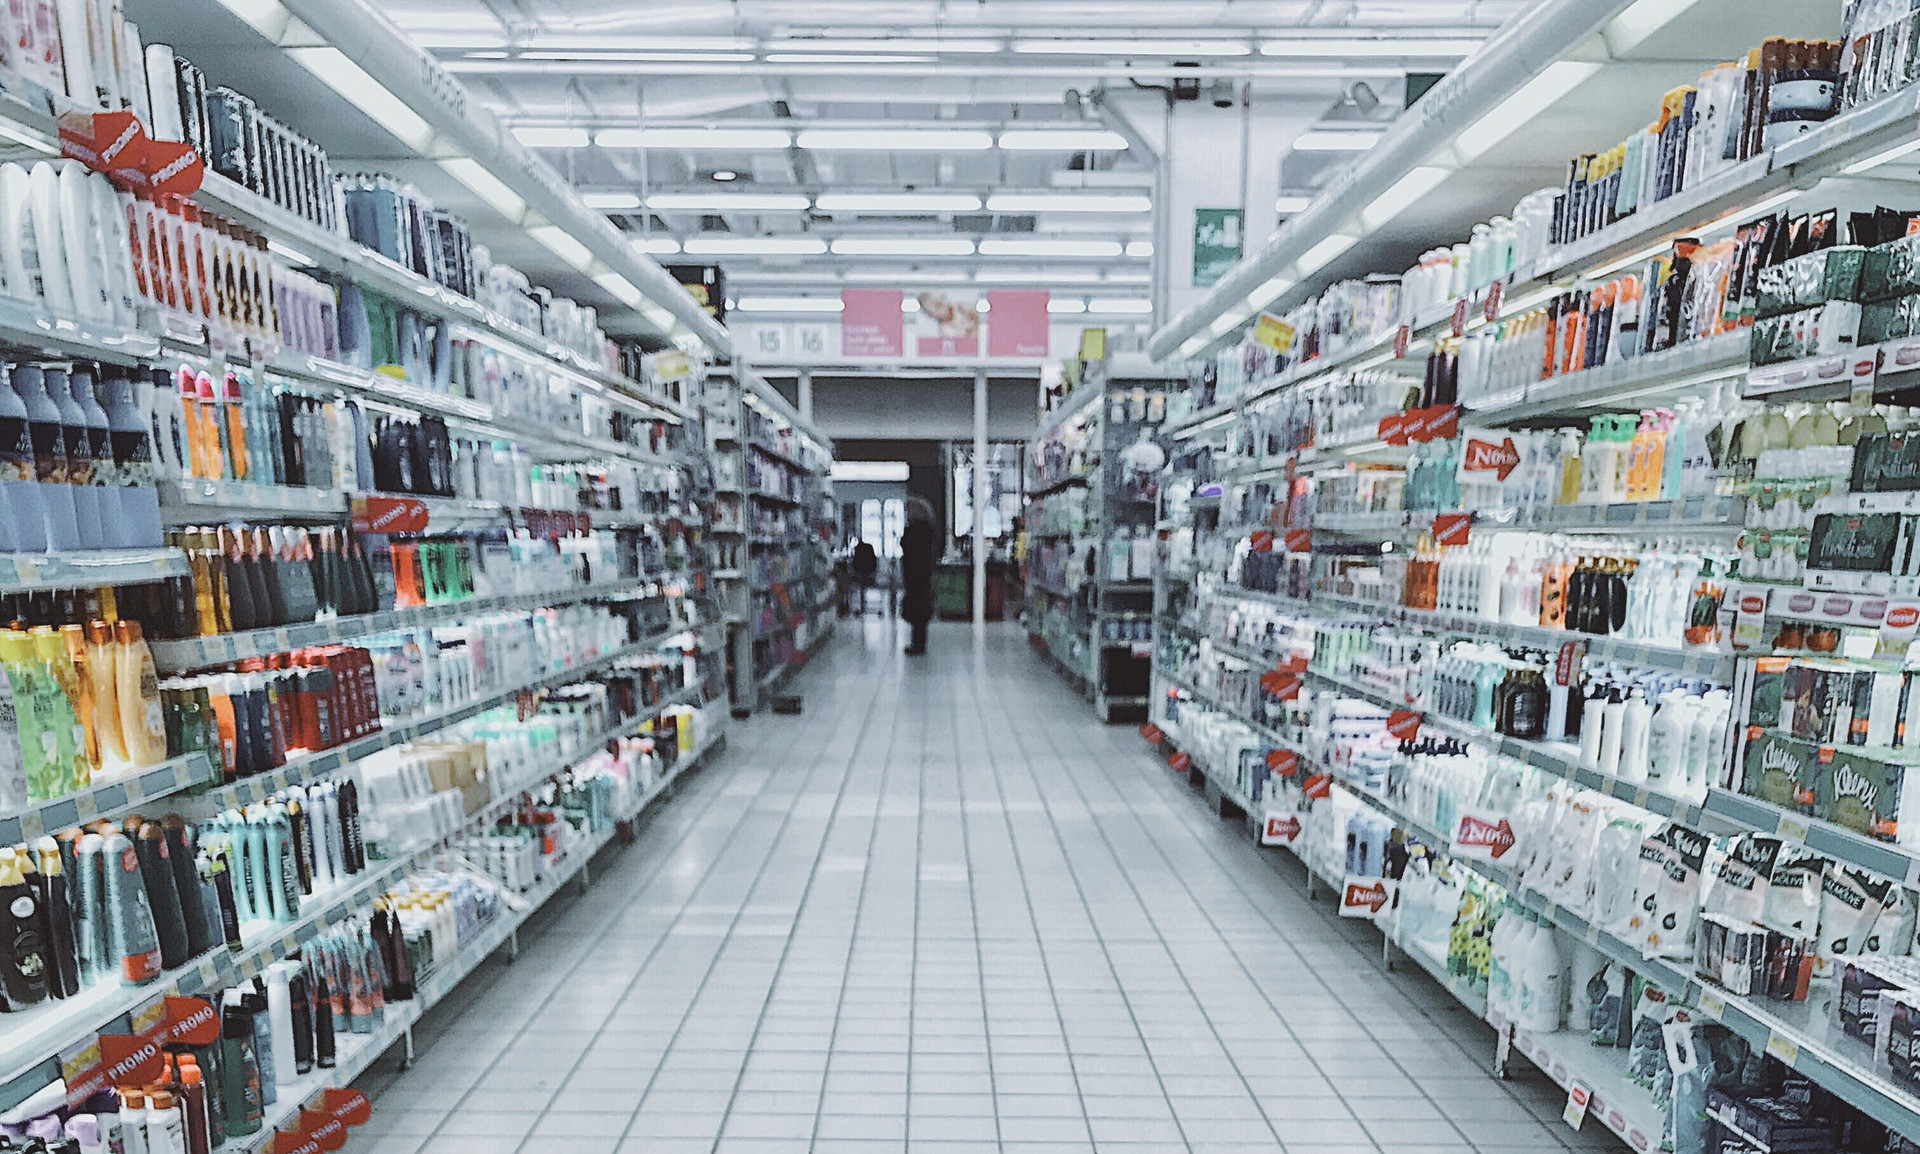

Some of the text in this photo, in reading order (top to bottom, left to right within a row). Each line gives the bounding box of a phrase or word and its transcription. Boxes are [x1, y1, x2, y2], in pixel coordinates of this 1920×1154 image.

[101, 120, 140, 164] PROMO
[151, 151, 197, 187] PROMO
[758, 331, 780, 352] 15
[802, 331, 823, 352] 16
[372, 502, 407, 529] PROMO
[172, 1006, 214, 1038] PROMO
[107, 1044, 156, 1081] PROMO
[311, 1119, 342, 1141] ROMO
